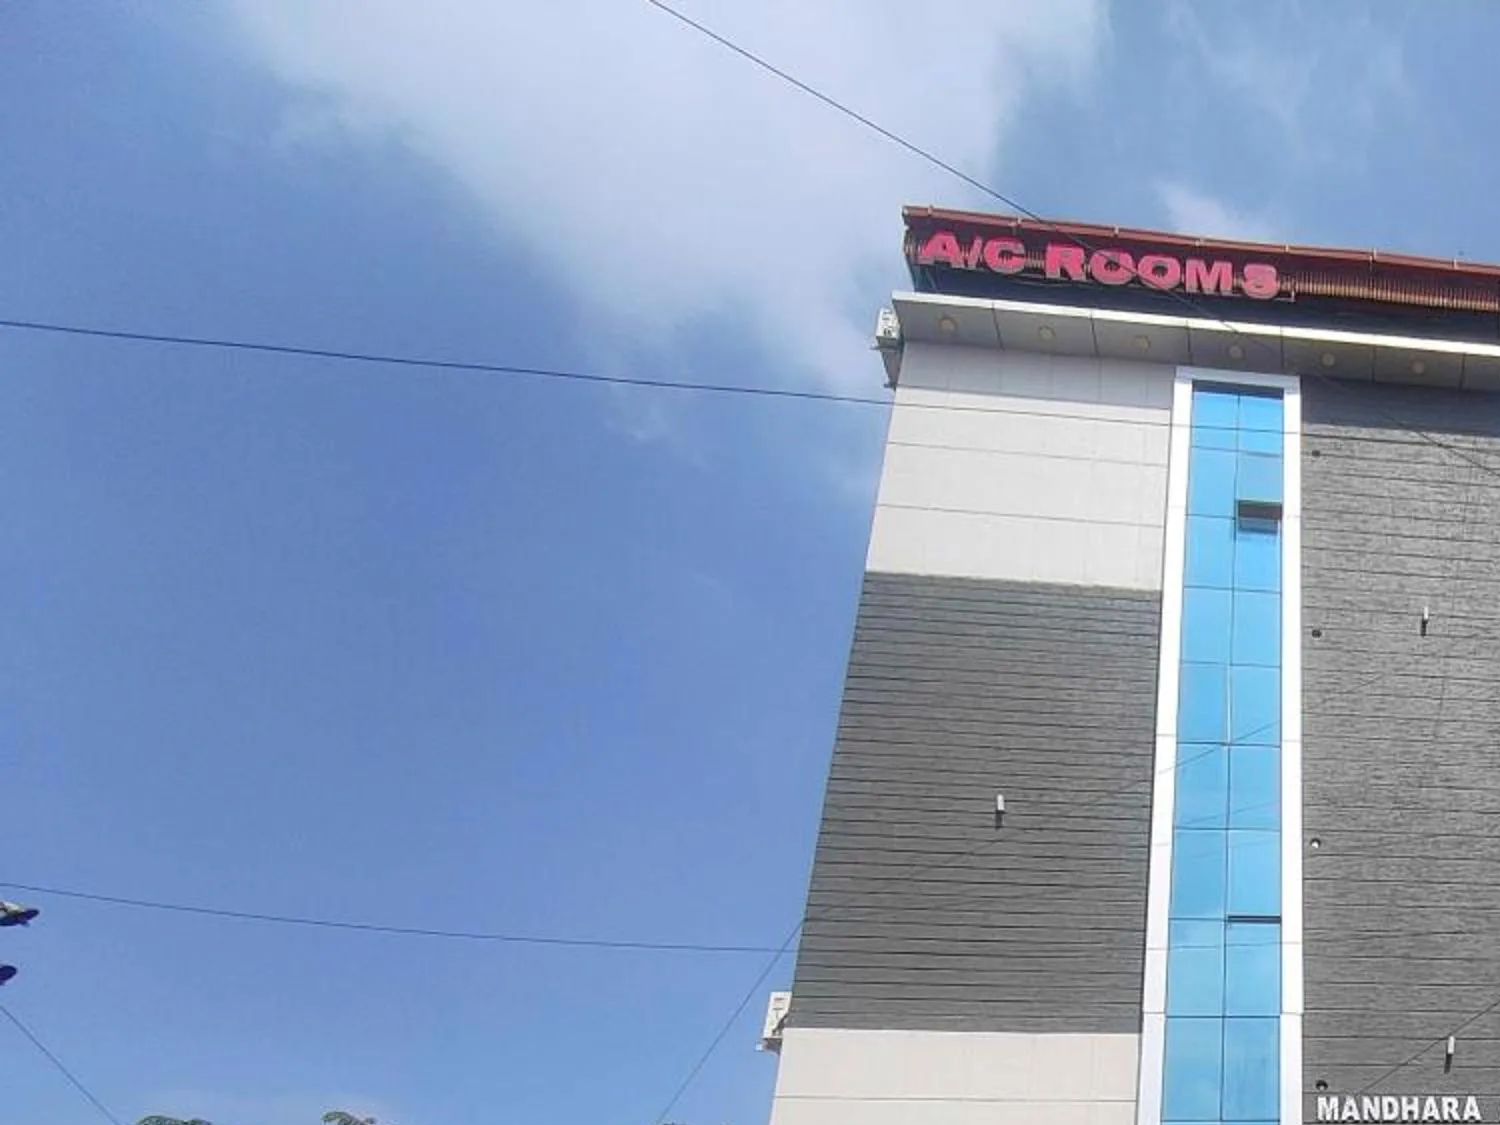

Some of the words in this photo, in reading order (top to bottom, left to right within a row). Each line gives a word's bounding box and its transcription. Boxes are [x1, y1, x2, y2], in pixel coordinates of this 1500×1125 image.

[919, 230, 1026, 274] A/C
[1045, 241, 1281, 298] ROOMS
[1317, 1095, 1482, 1122] MANDHARA
